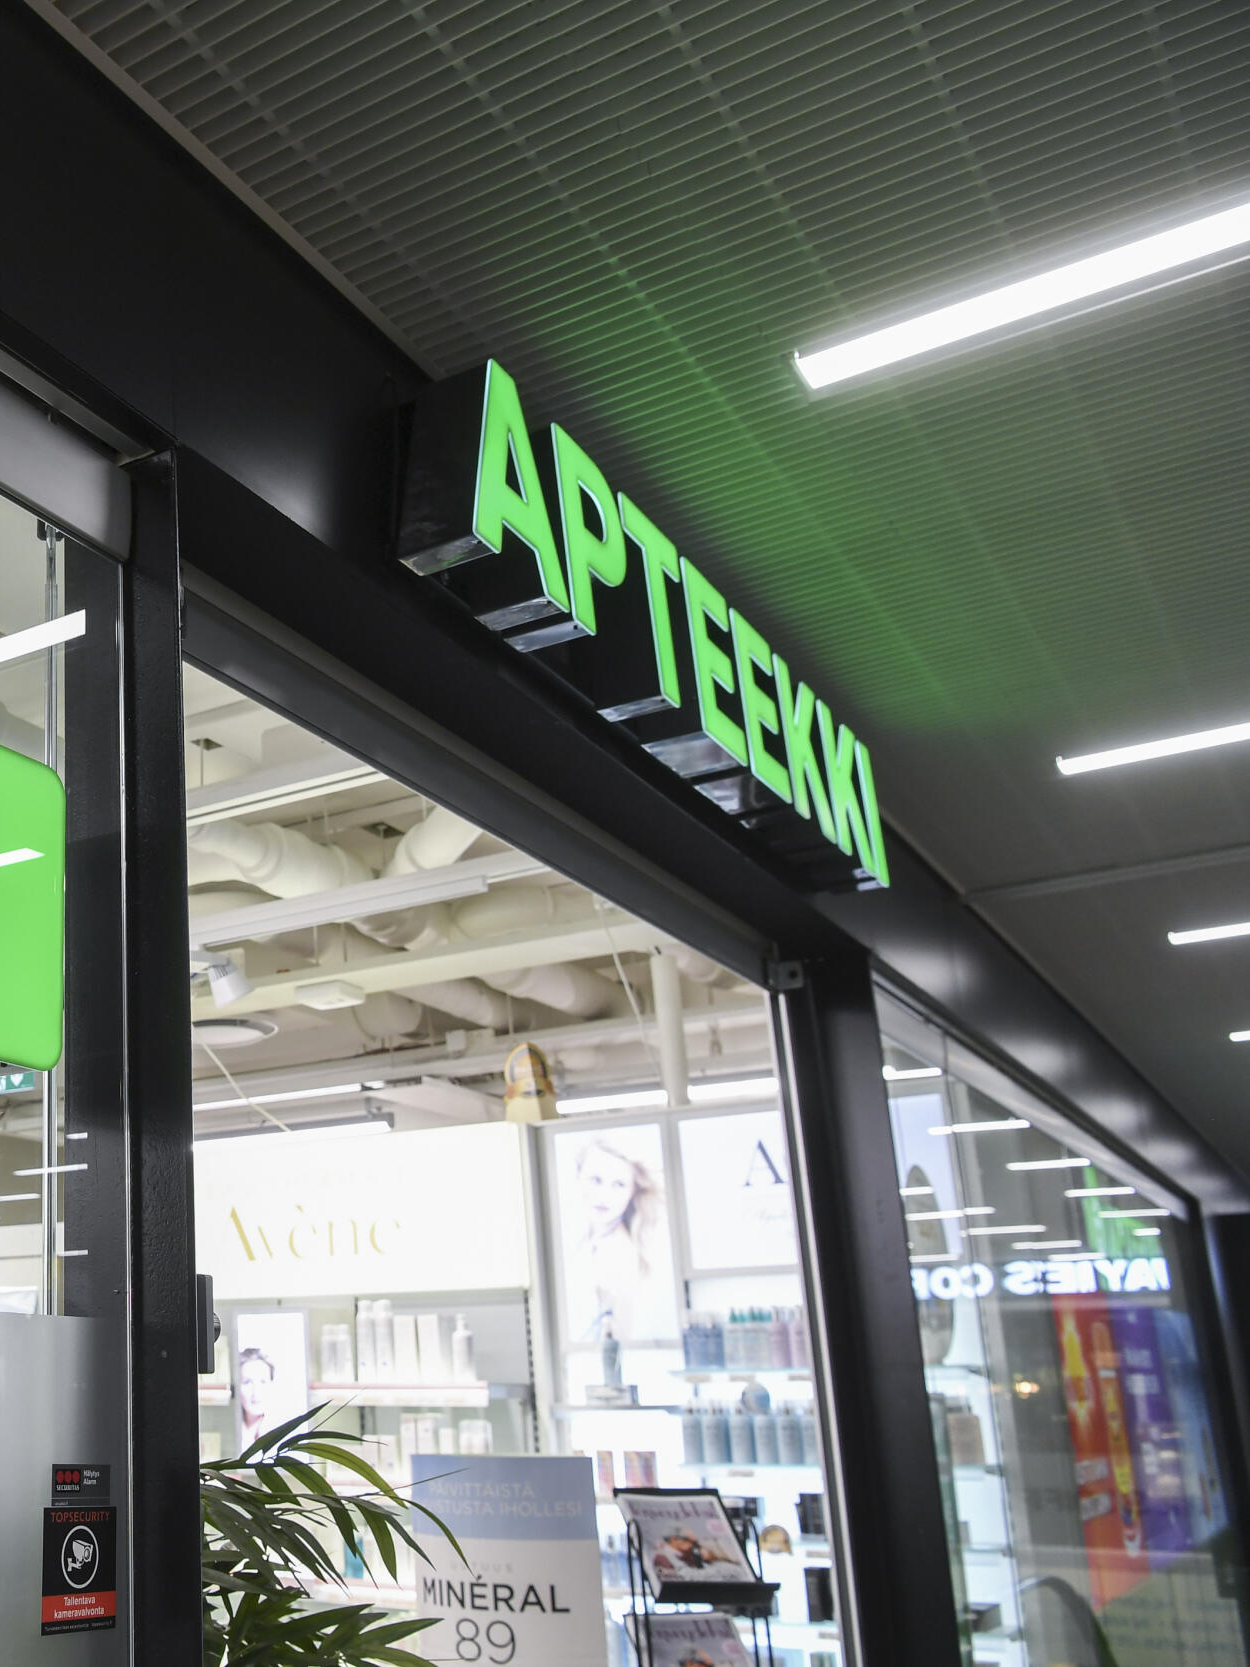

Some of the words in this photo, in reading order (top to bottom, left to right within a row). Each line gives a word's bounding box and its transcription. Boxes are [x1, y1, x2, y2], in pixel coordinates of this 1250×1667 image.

[473, 358, 890, 888] APTEEKKI
[51, 1511, 110, 1523] TOPSECURITY
[63, 1595, 96, 1607] Tallentava
[423, 1575, 571, 1614] MINÉRAL
[53, 1606, 105, 1619] kameravalvonta
[456, 1618, 517, 1665] 89
